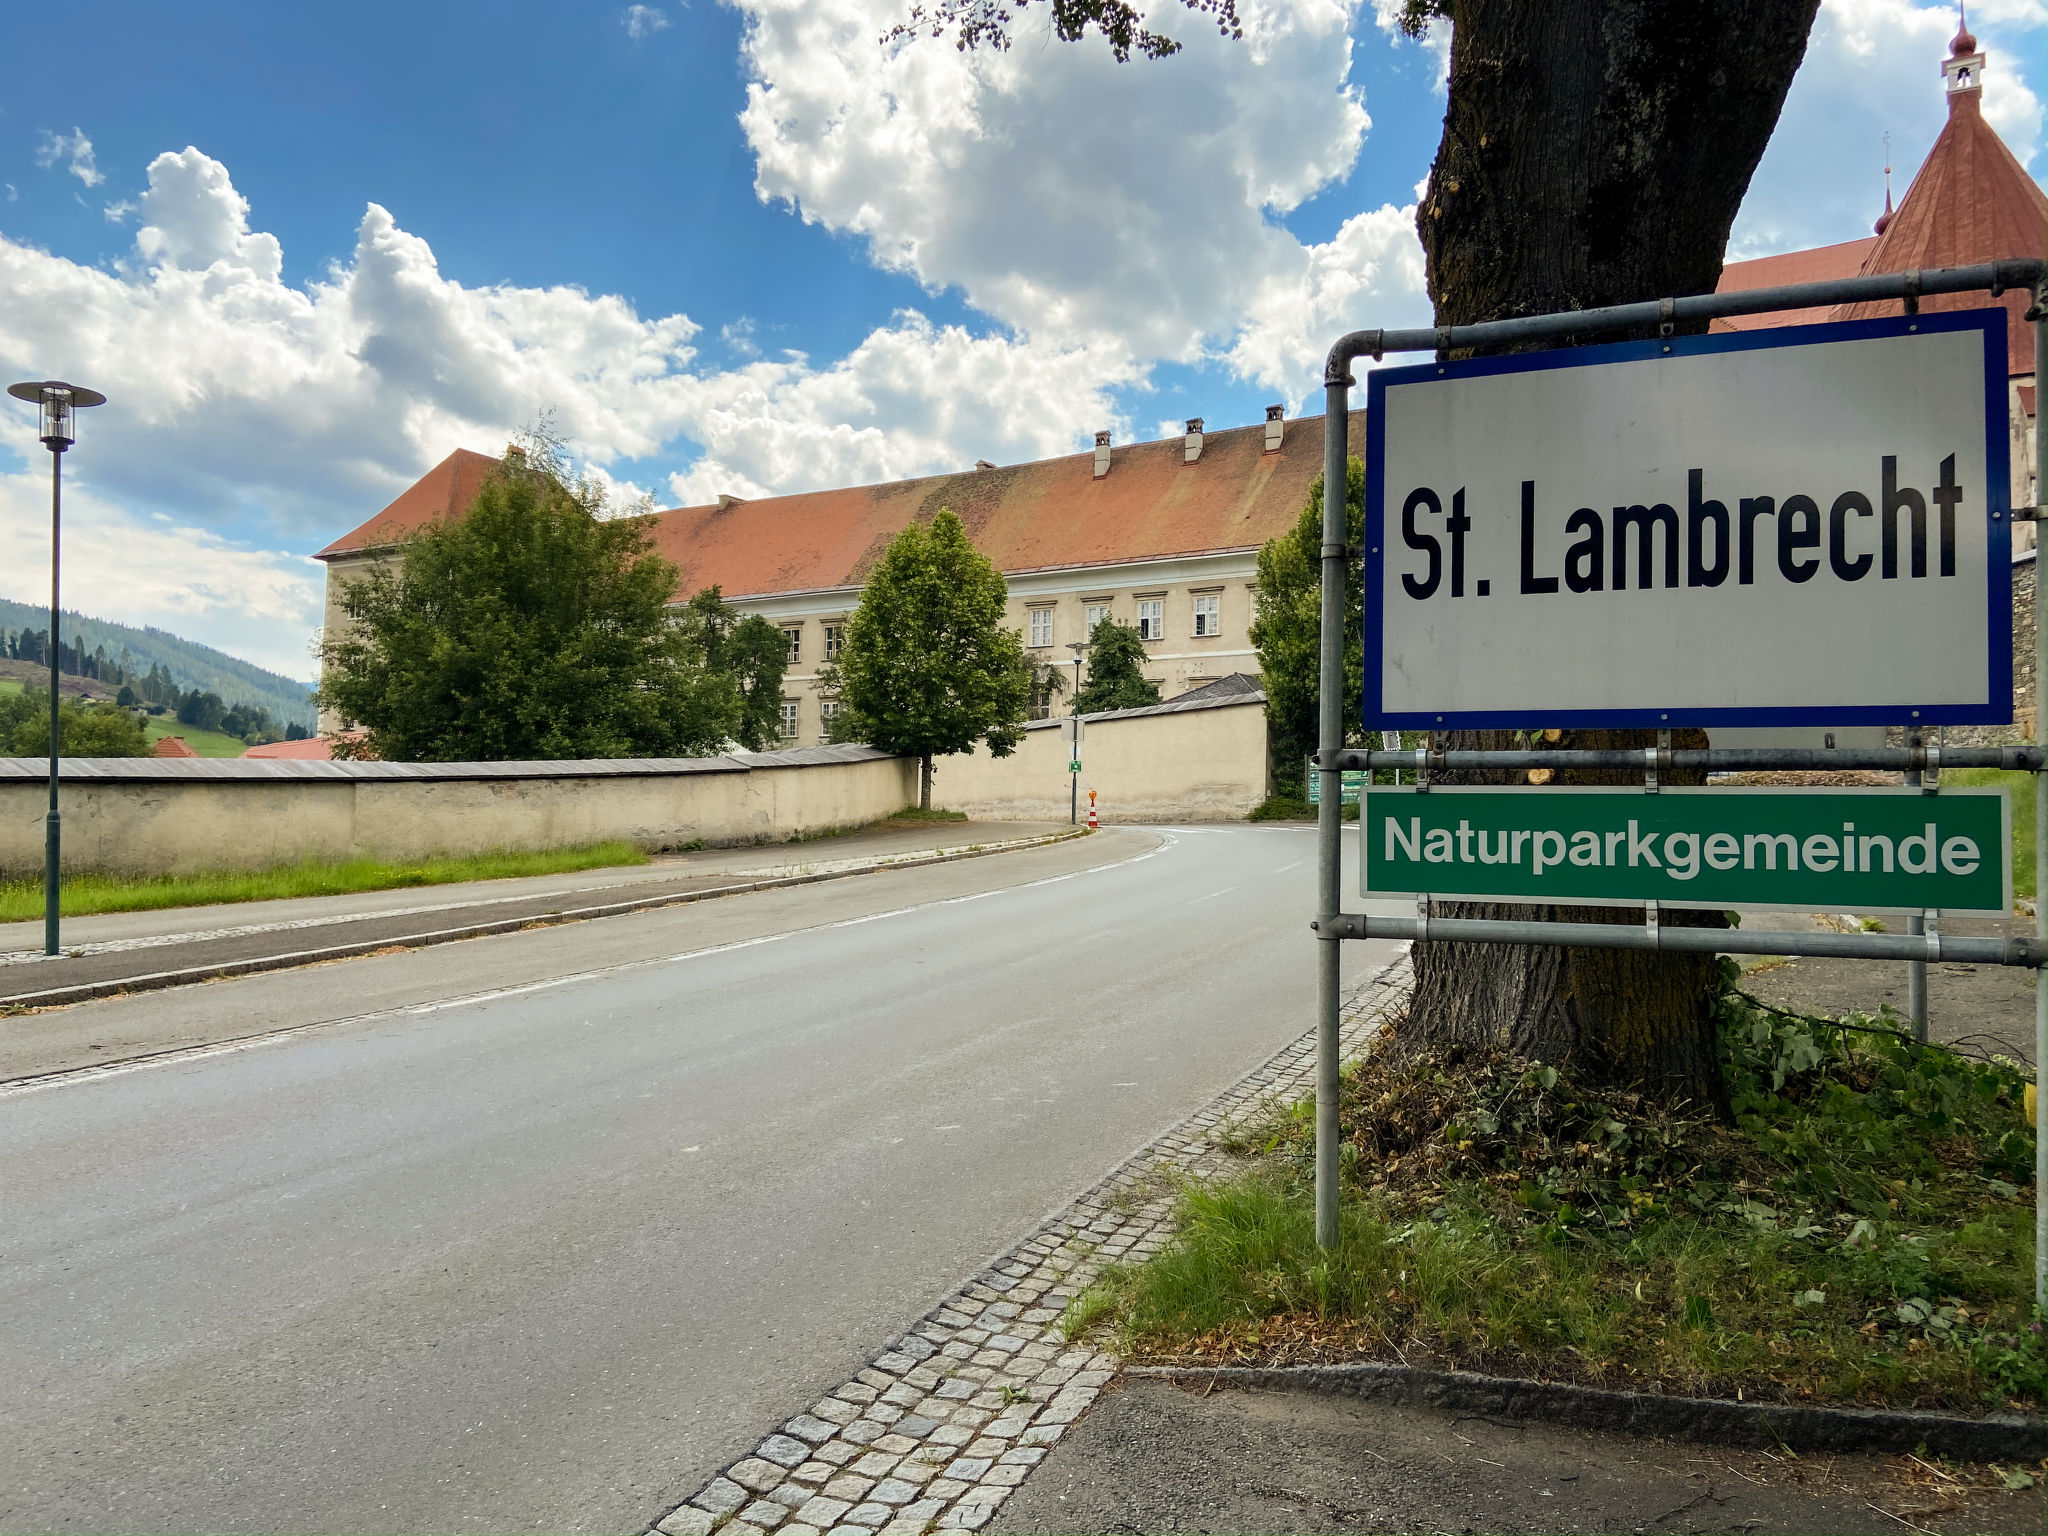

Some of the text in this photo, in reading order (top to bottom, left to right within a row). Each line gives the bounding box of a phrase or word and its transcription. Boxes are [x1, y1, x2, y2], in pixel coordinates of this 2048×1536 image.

[1401, 452, 1964, 601] St. Lambrecht
[1384, 816, 1981, 880] Naturparkgemeinde
